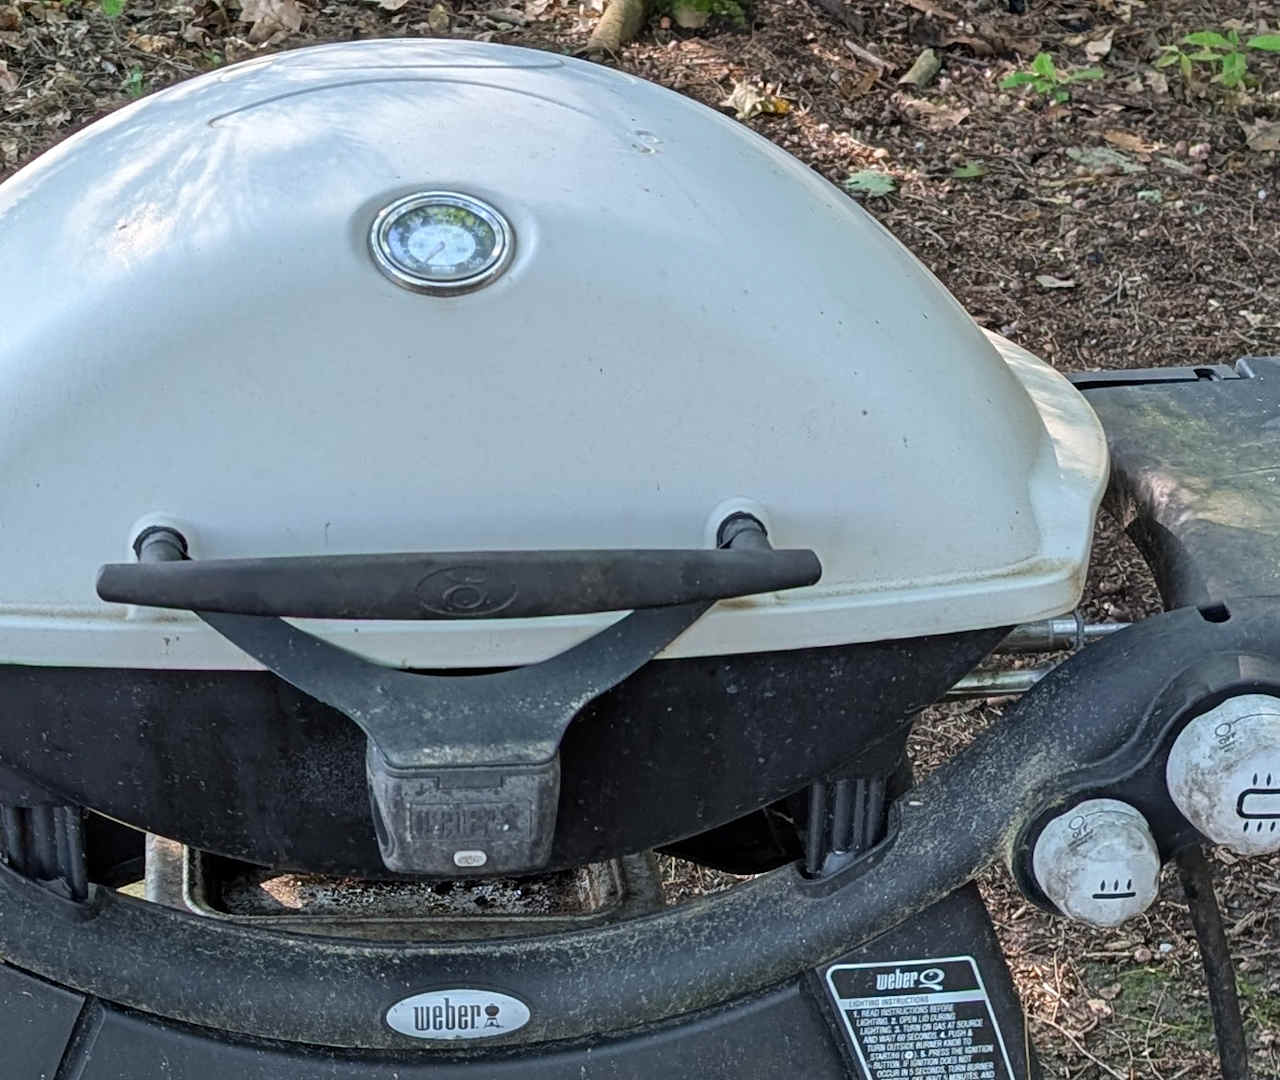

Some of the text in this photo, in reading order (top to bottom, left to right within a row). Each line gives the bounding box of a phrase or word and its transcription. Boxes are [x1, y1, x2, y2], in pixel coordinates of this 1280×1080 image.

[876, 968, 918, 990] weber
[413, 997, 481, 1031] weber
[880, 1006, 928, 1016] INSTRUCTIONS
[928, 1047, 950, 1056] PRESS
